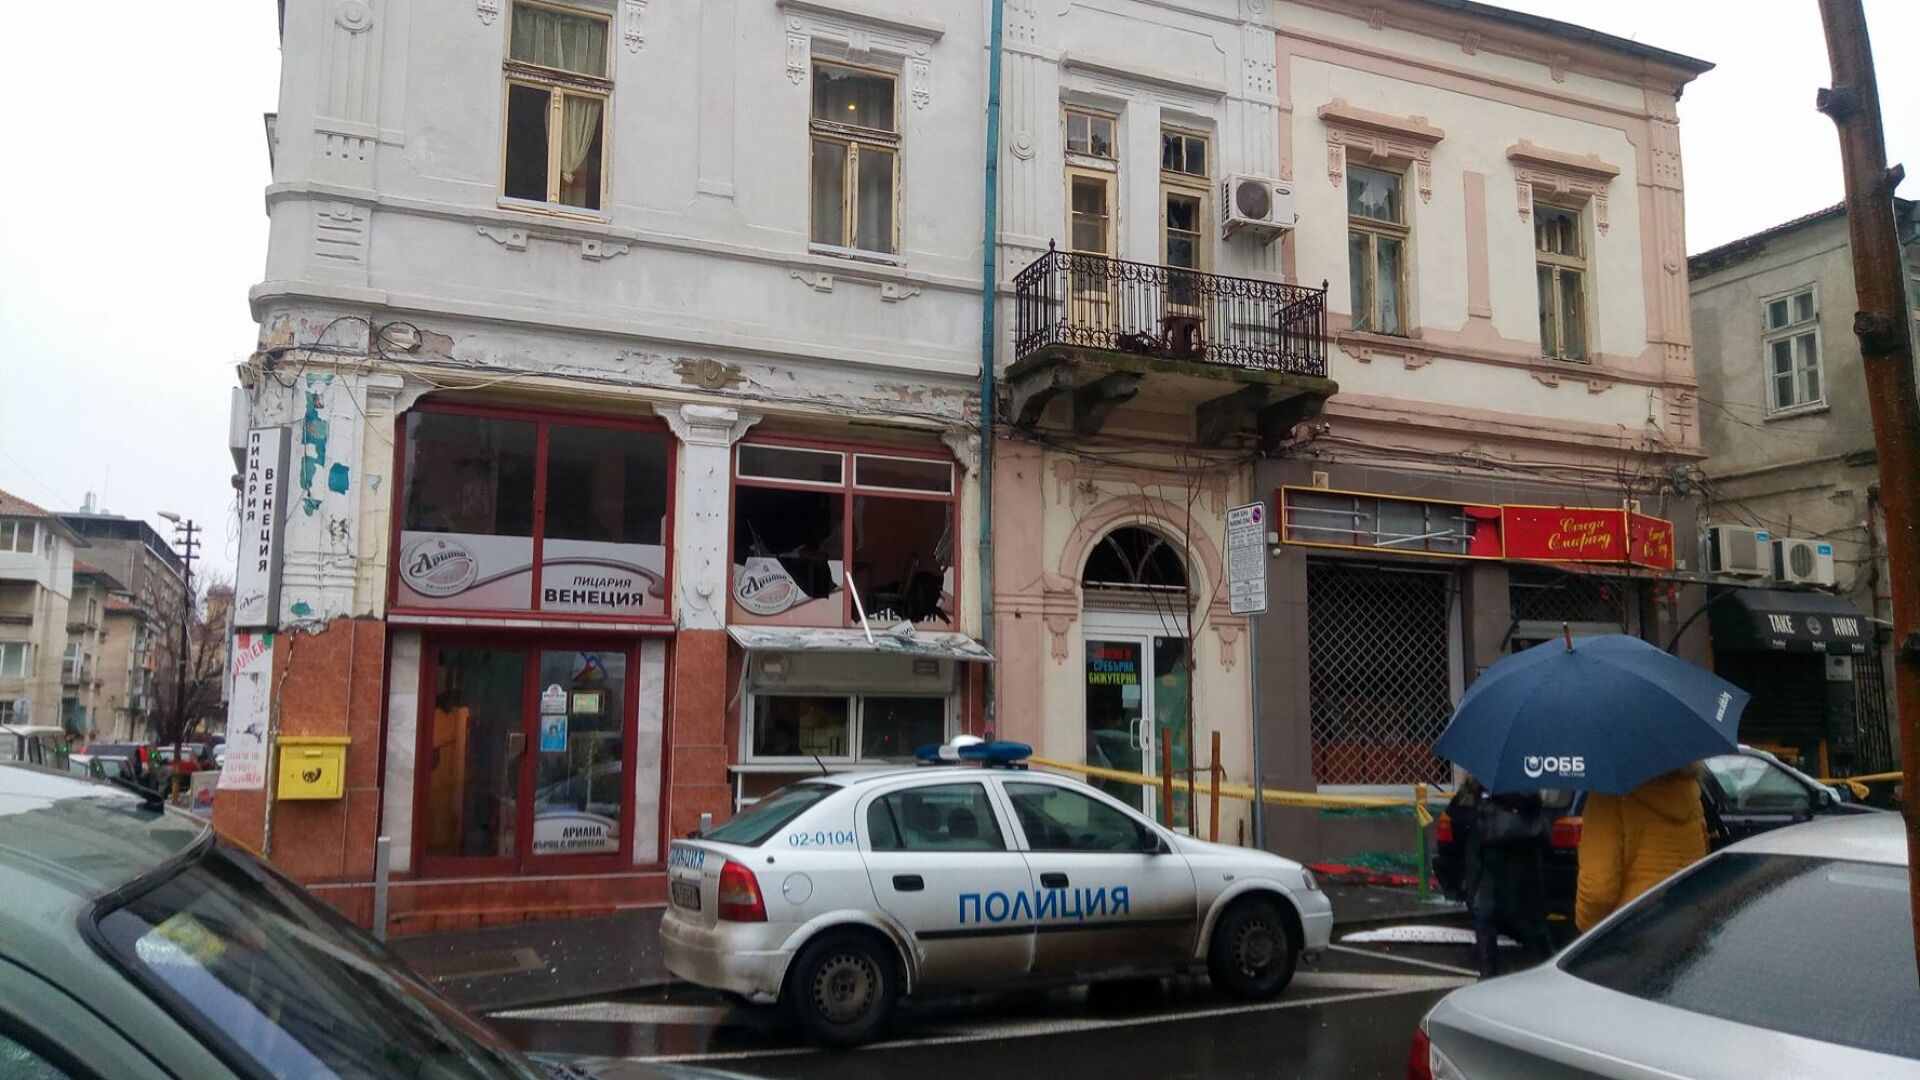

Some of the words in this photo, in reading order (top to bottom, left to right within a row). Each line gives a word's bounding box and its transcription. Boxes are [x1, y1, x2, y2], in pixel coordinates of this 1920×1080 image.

[247, 432, 261, 521] ПИЦАРИЯ
[258, 468, 275, 572] ВЕНЕЦИЯ
[573, 575, 632, 588] ПИЦАРИЯ
[544, 588, 644, 608] ВЕНЕЦИЯ
[1768, 614, 1796, 634] TAKE
[1832, 616, 1859, 637] AWAY
[789, 830, 855, 847] 02-0104
[959, 886, 1130, 924] ПОЛИЦИЯ
